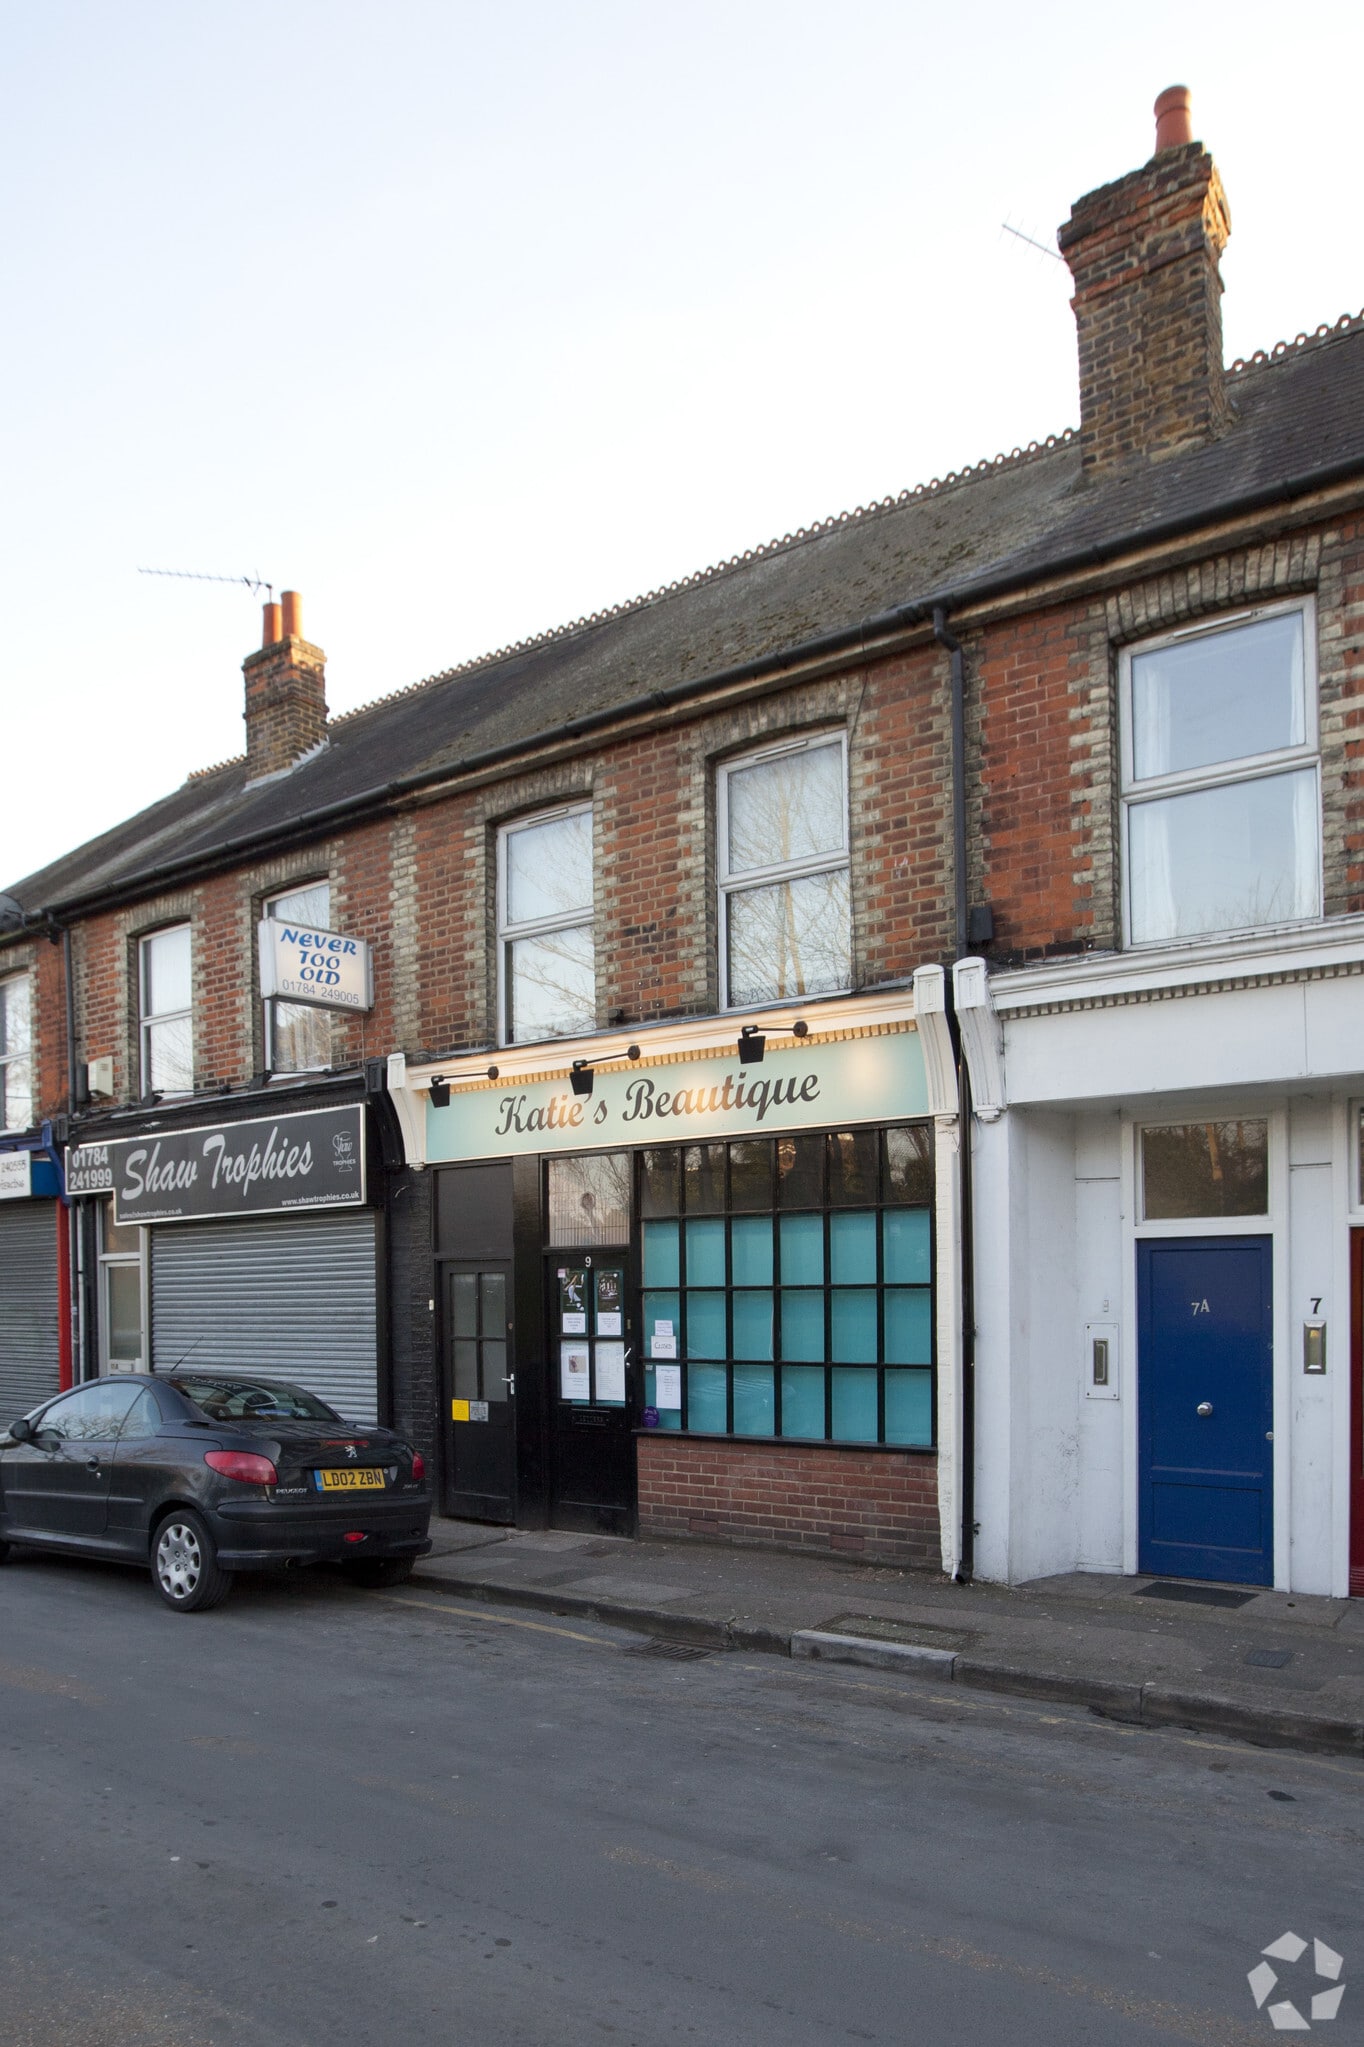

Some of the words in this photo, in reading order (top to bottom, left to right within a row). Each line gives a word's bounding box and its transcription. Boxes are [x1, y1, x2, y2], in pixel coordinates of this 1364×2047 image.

[280, 928, 356, 955] NEVER
[299, 950, 340, 970] TOO
[299, 966, 340, 986] OLD
[282, 979, 315, 995] 01784
[321, 987, 359, 1004] 249005
[494, 1093, 608, 1135] Katie's
[622, 1071, 821, 1121] Beautique
[72, 1146, 108, 1168] 01784
[121, 1141, 198, 1200] Shaw
[203, 1126, 314, 1197] Trophies
[69, 1168, 113, 1190] 241999
[281, 1190, 360, 1206] www.shawtrophies.co.uk
[585, 1256, 592, 1268] 9
[1191, 1299, 1211, 1316] 7A
[1310, 1297, 1323, 1315] 7
[359, 1470, 382, 1486] ZBN
